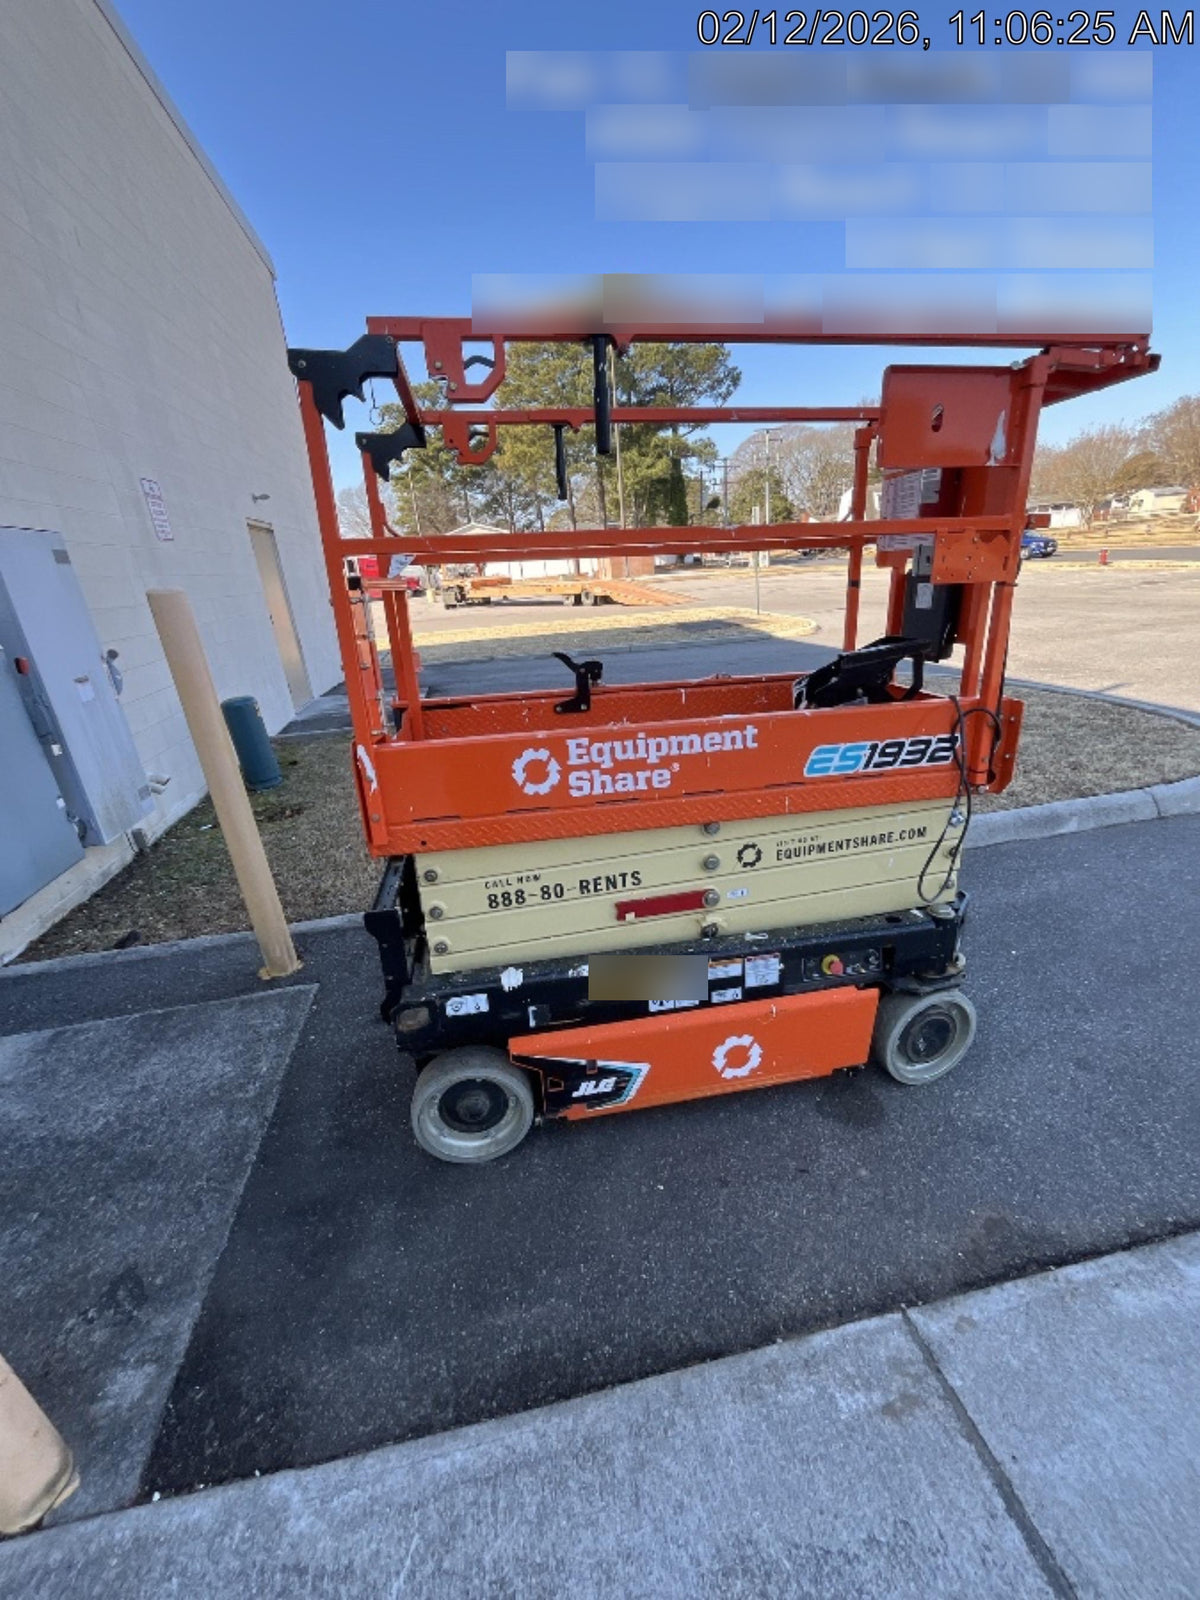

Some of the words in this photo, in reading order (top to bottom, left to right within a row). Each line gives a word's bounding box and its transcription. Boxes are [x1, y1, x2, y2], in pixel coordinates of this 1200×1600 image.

[566, 725, 759, 770] Equipment
[804, 734, 958, 777] ES1932
[776, 826, 927, 861] EQUIPMENTSHARE.COM
[484, 877, 513, 890] CALL
[571, 1077, 618, 1098] JLG
